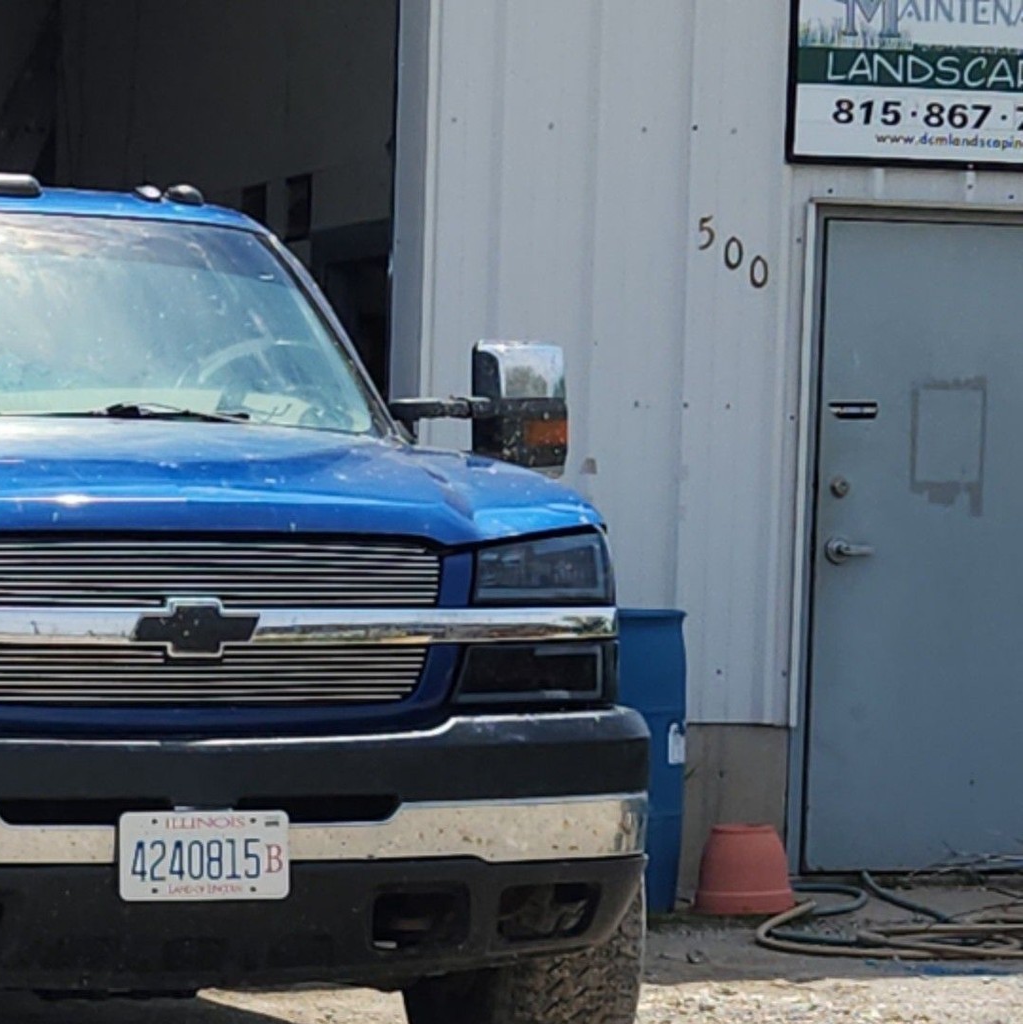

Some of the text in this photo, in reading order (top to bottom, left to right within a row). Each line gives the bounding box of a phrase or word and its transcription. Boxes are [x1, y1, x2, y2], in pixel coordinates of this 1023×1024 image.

[827, 51, 1023, 89] LANDSCA
[698, 214, 769, 289] 500
[165, 816, 246, 830] ILLINOIS
